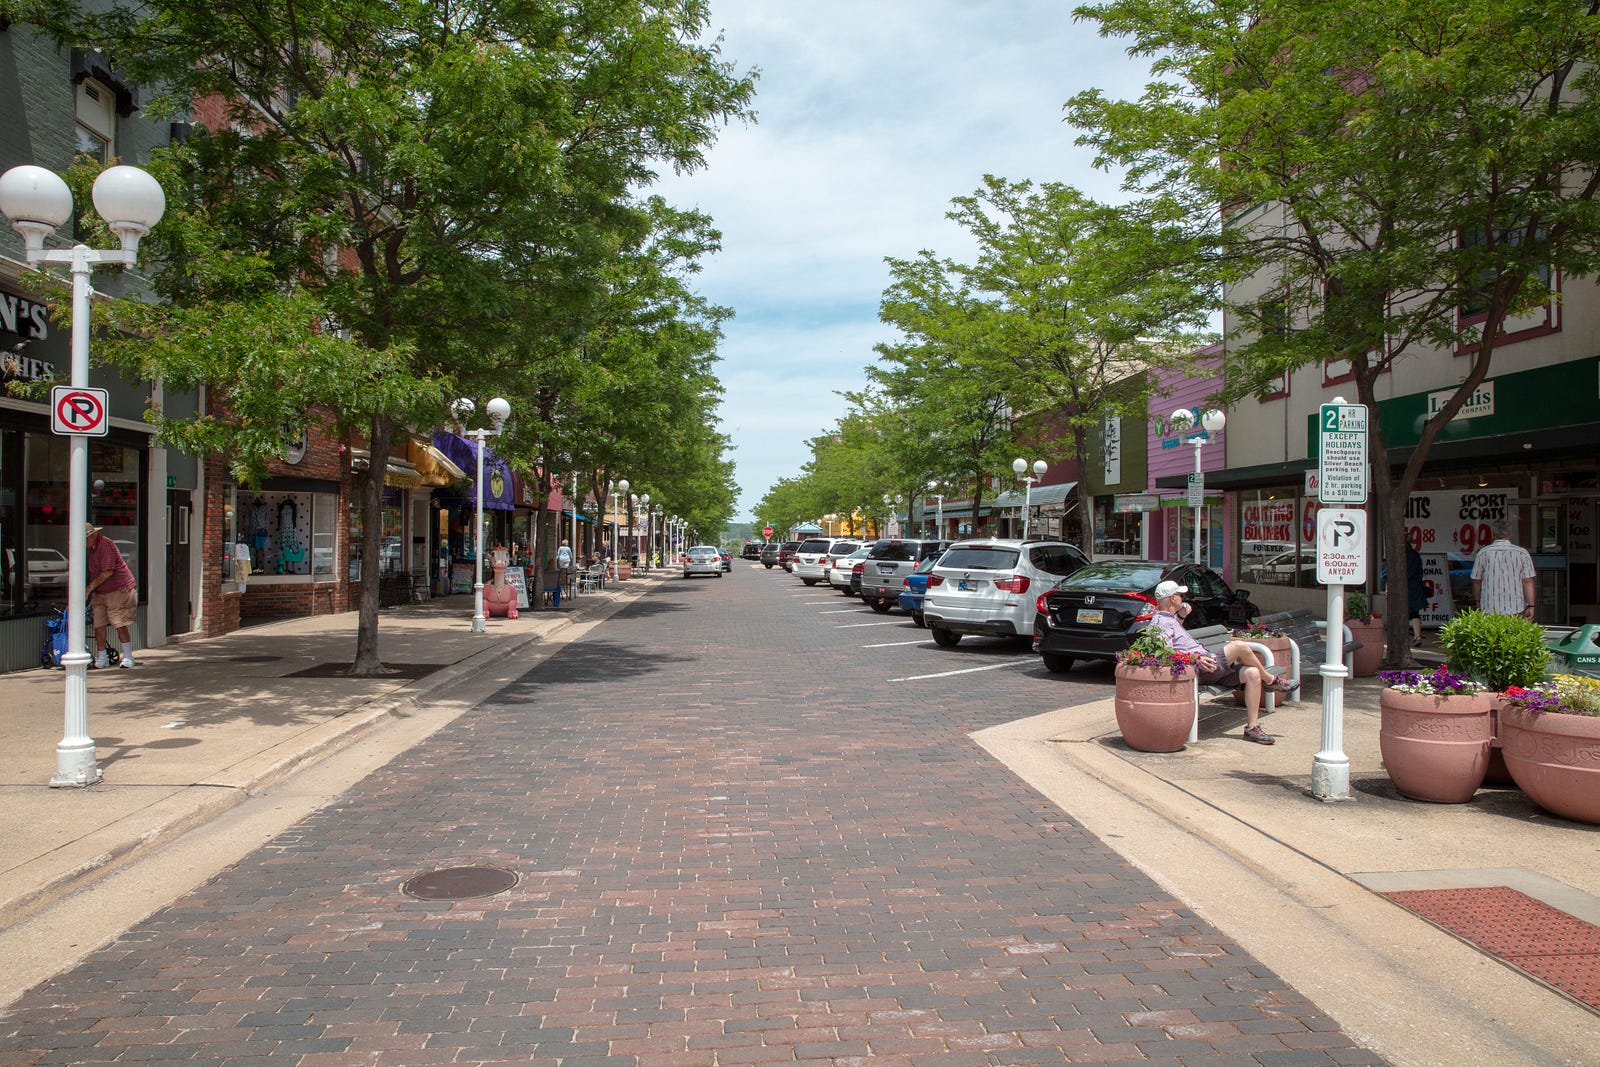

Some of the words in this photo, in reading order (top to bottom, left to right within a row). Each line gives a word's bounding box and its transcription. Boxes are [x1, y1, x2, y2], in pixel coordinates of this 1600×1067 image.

[1430, 389, 1491, 413] Ladis
[1326, 410, 1337, 428] 2
[1348, 409, 1356, 418] HR
[1339, 419, 1365, 430] PARKING
[1328, 432, 1359, 440] EXCEPT
[1325, 441, 1362, 449] HOLIDAYS
[1340, 482, 1362, 490] parking
[1461, 493, 1507, 508] SPORT
[1404, 496, 1431, 519] UITS
[1459, 507, 1505, 520] COATS
[1243, 523, 1291, 542] BUSINESS
[1253, 543, 1284, 552] FOREVER
[1324, 560, 1359, 568] 6:00a.m.
[1425, 558, 1437, 567] AN
[1328, 568, 1356, 576] ANYDAY
[1431, 613, 1450, 621] PRICE
